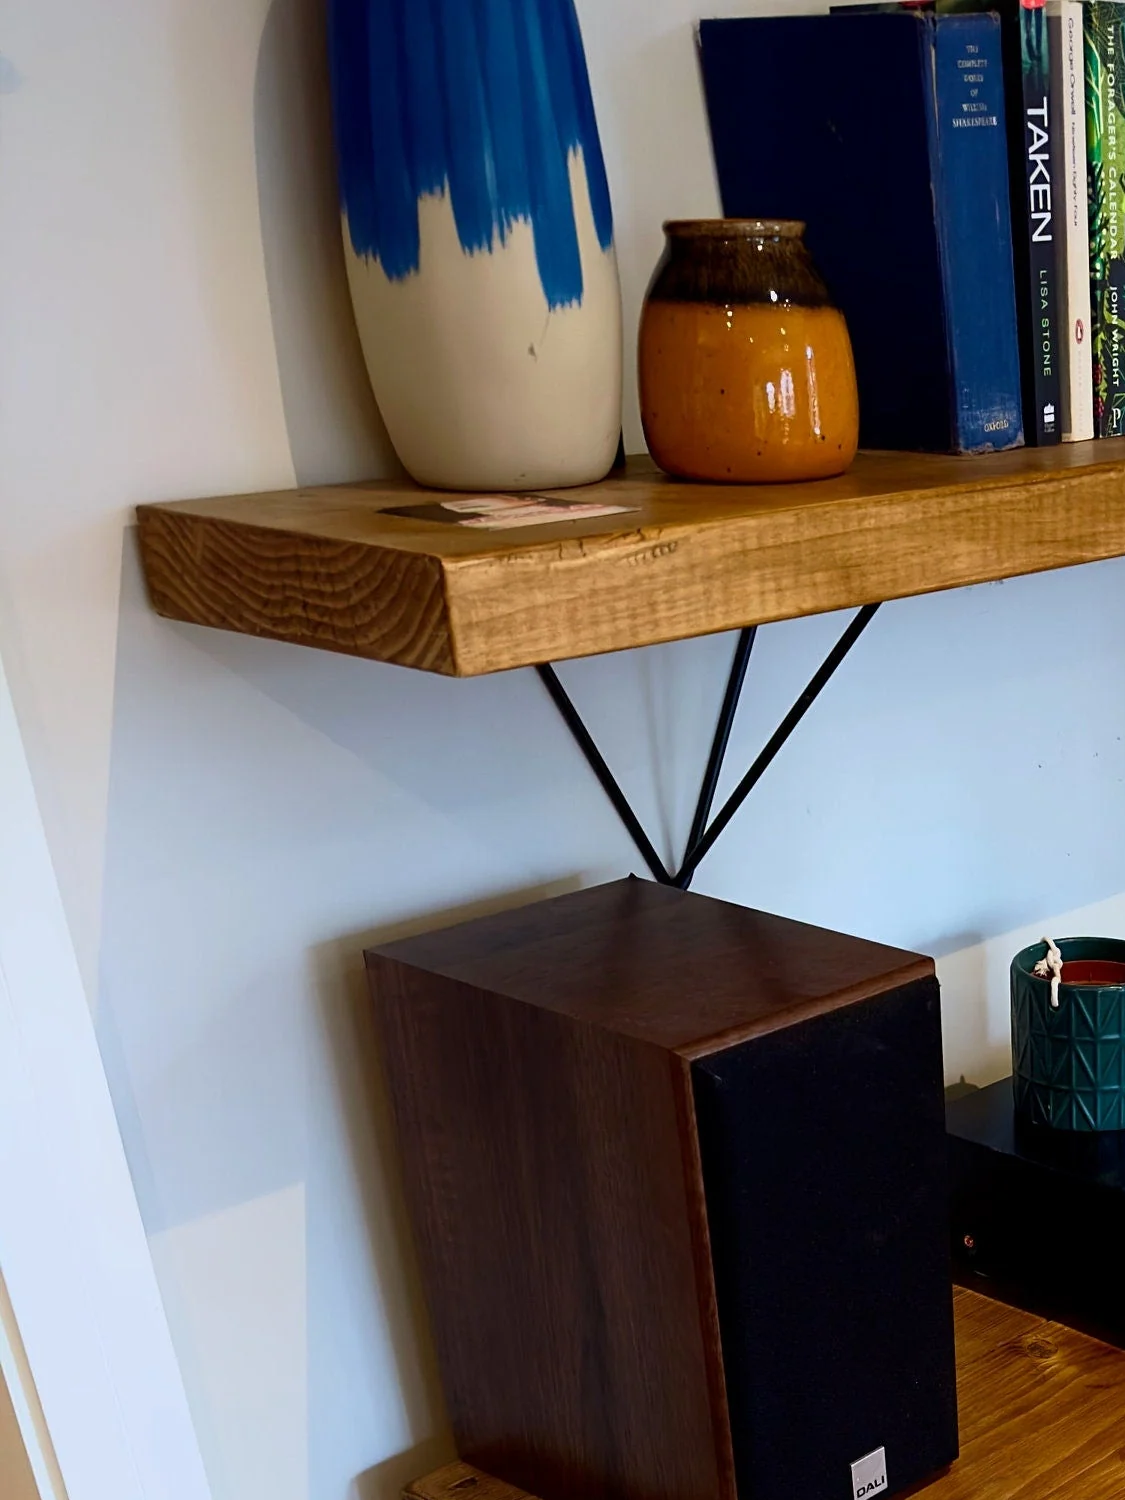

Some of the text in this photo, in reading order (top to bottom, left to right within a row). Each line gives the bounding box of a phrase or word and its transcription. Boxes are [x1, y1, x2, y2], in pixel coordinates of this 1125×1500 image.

[1027, 96, 1053, 242] TAKEN
[1107, 25, 1118, 260] THE FORAGER'S CALENDAR
[1039, 270, 1052, 377] LISA STONE
[1109, 286, 1120, 387] JOHN WRIGHT
[984, 420, 1009, 433] OXFORD
[856, 1475, 885, 1498] DALI
